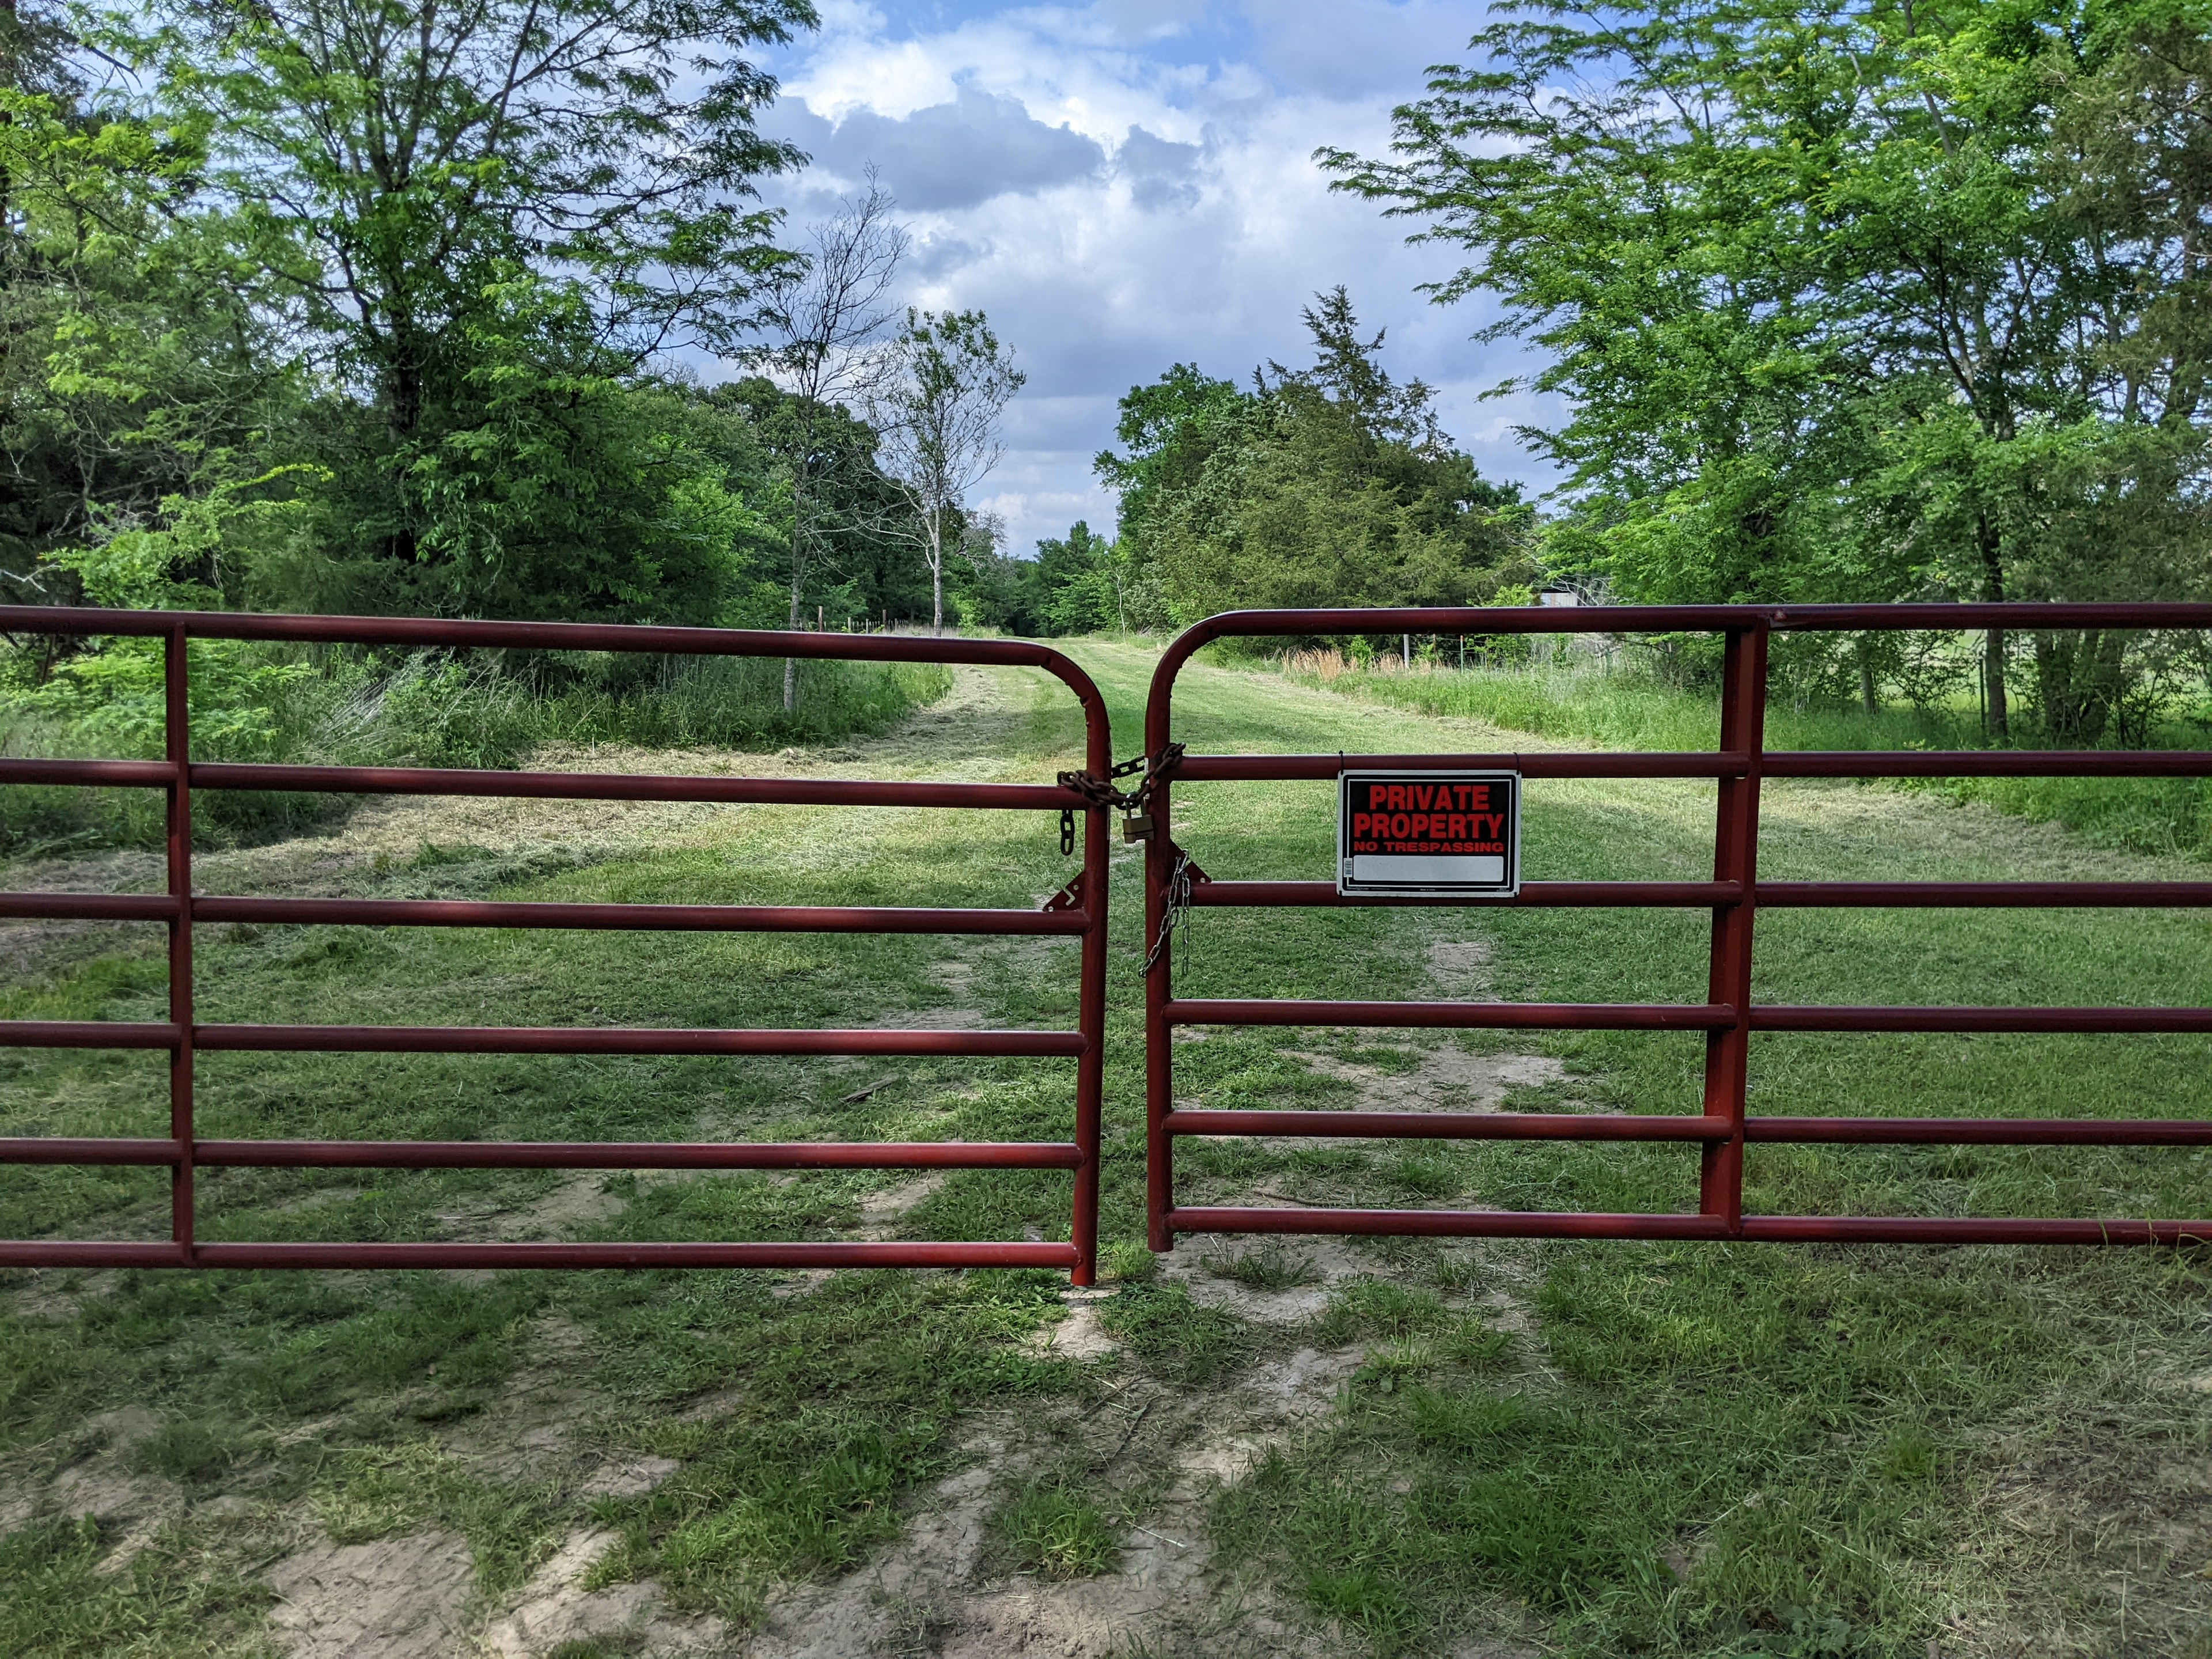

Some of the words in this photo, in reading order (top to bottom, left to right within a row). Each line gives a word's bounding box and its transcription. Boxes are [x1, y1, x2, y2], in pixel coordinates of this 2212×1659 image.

[1369, 785, 1490, 810] PRIVATE
[1354, 813, 1504, 839] PROPERTY
[1354, 841, 1378, 851] NO
[1384, 842, 1504, 853] TRESPASSING
